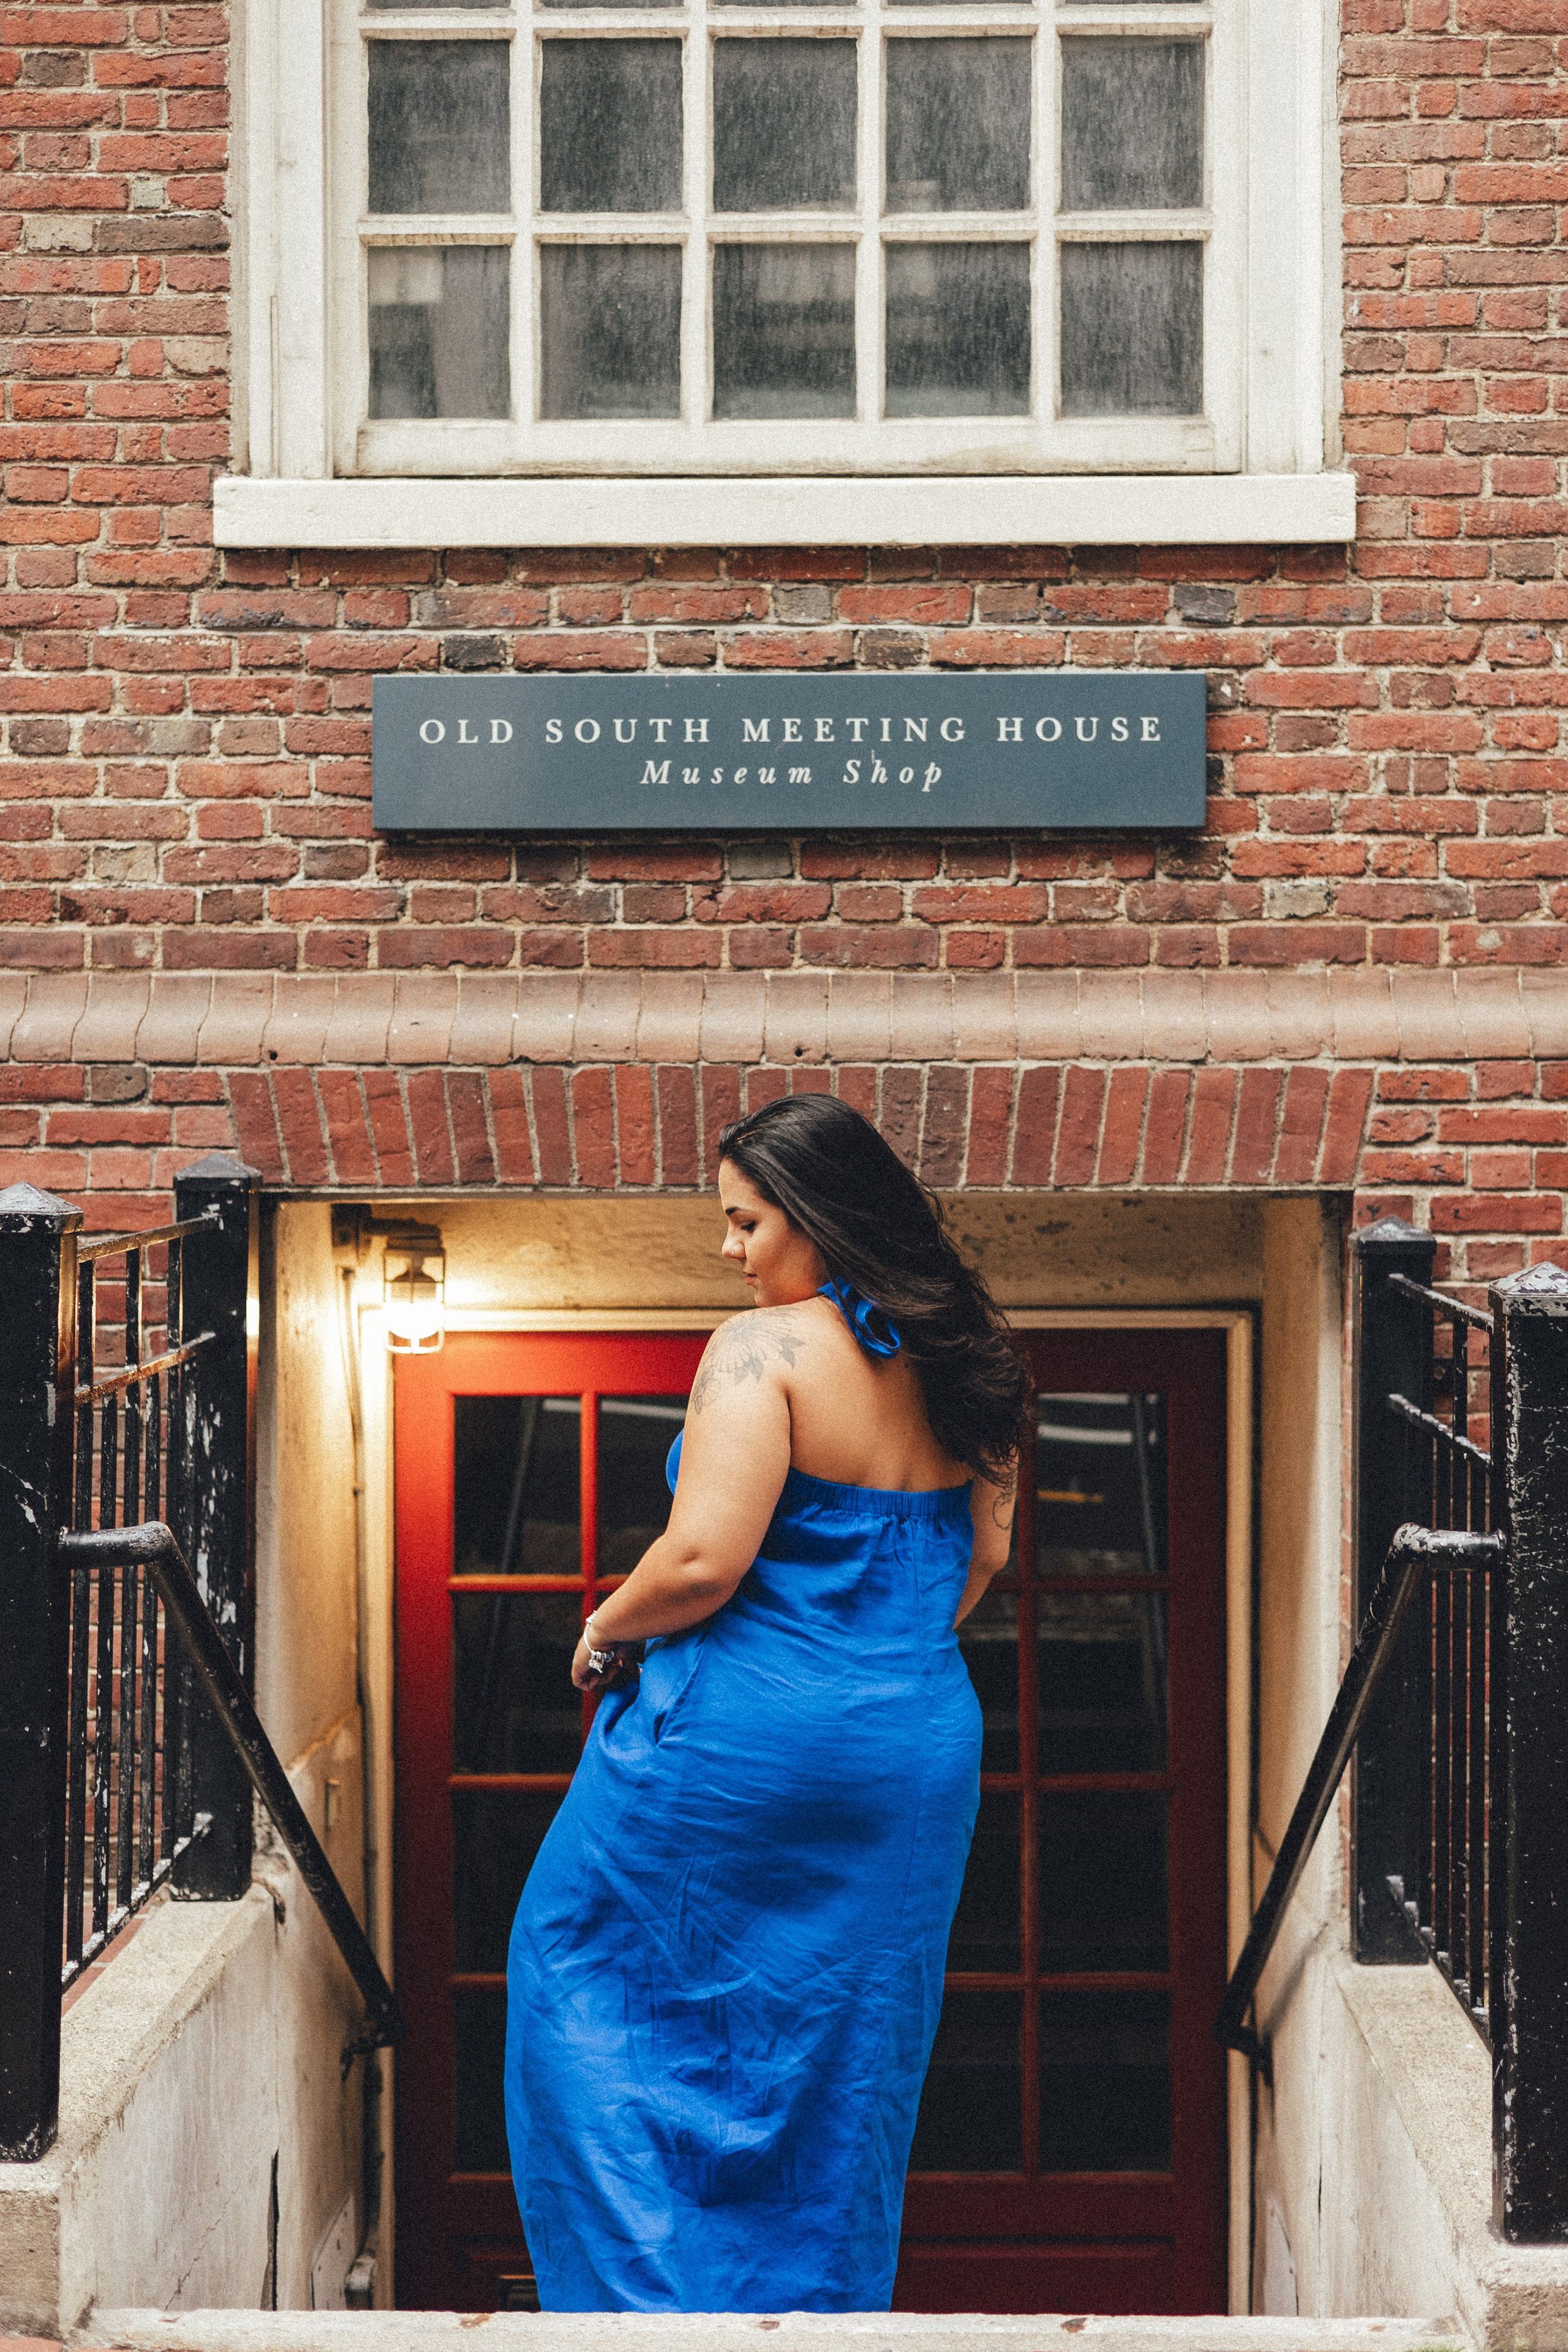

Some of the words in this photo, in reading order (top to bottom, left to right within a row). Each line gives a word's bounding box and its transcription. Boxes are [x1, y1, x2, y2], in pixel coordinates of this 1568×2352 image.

[418, 718, 514, 744] OLD
[545, 717, 710, 744] SOUTH
[741, 717, 966, 742] MEETING
[997, 716, 1162, 742] HOUSE
[640, 759, 813, 785] Museum
[842, 758, 943, 793] Shop
